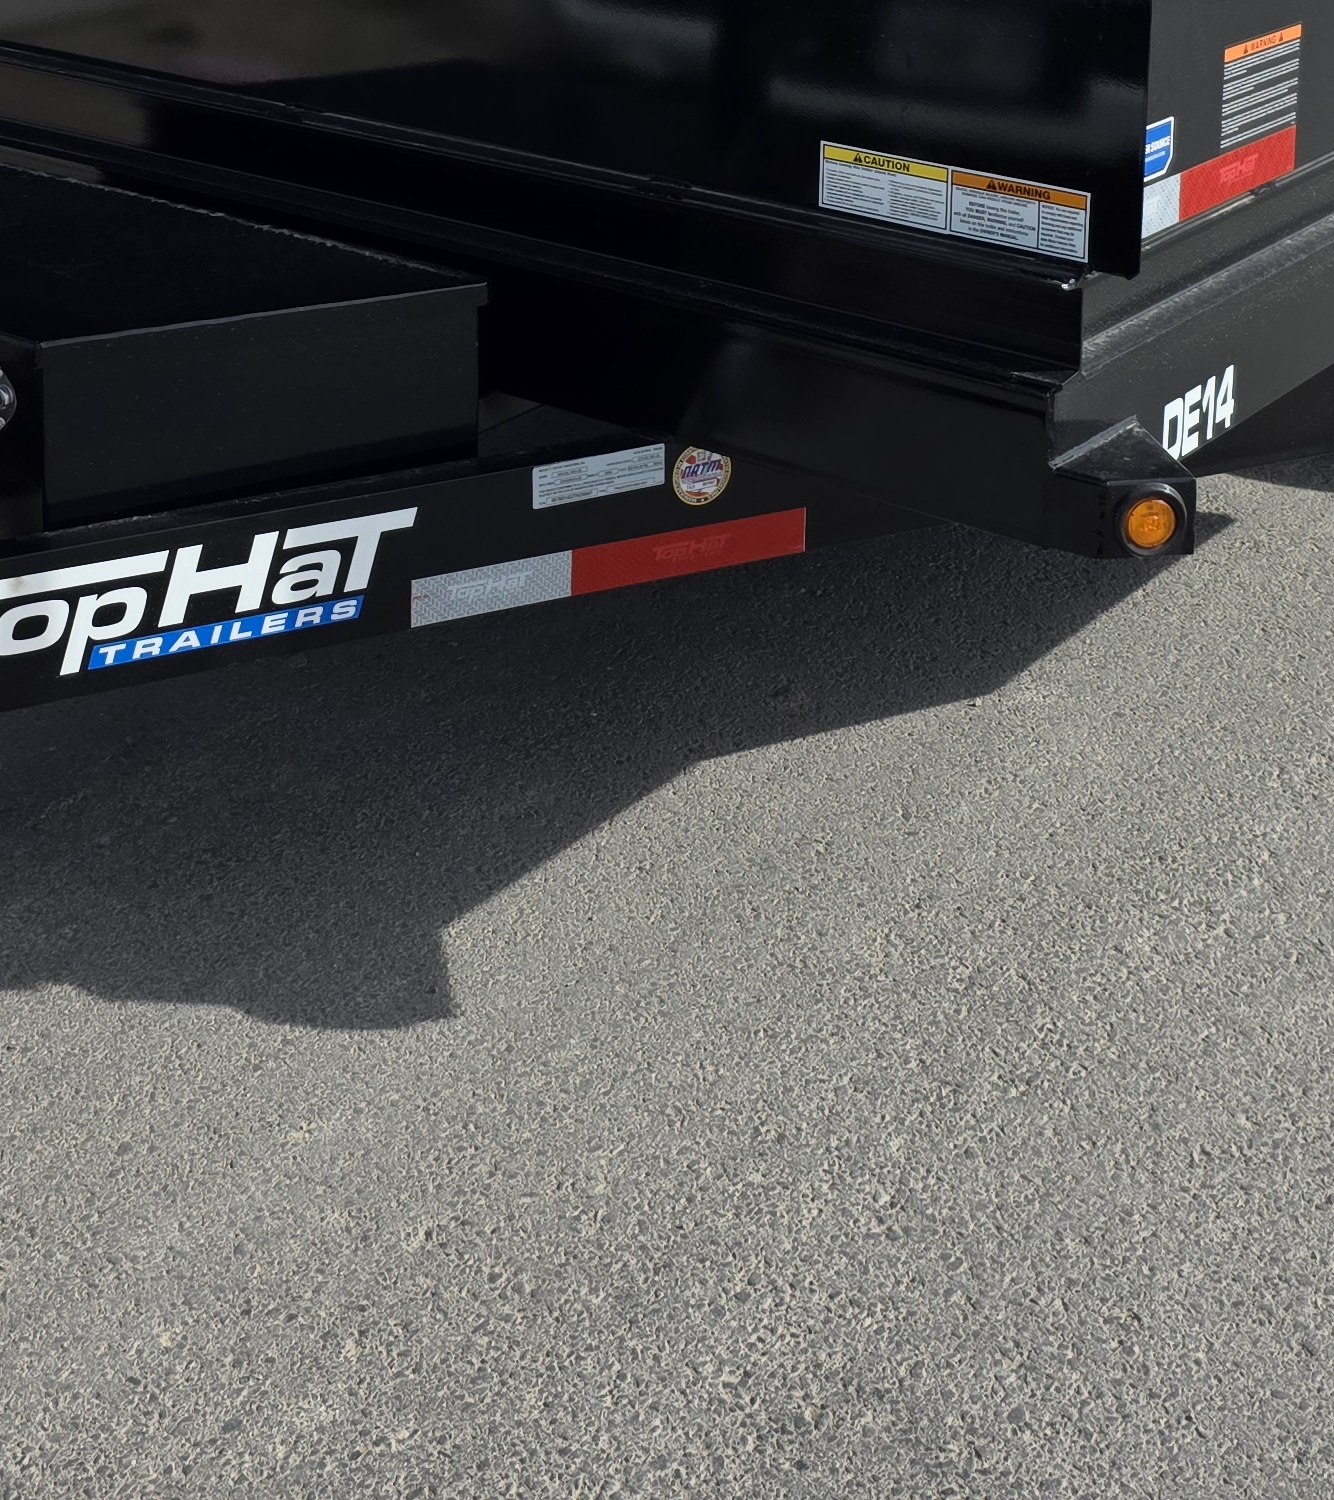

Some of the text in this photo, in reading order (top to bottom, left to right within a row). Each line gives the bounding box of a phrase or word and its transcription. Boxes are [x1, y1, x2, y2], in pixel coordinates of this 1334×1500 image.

[1250, 35, 1276, 51] WARNING
[863, 155, 911, 173] CAUTION
[997, 182, 1051, 200] WARNING
[1162, 364, 1235, 461] DE14
[98, 599, 361, 666] TRAILERS
